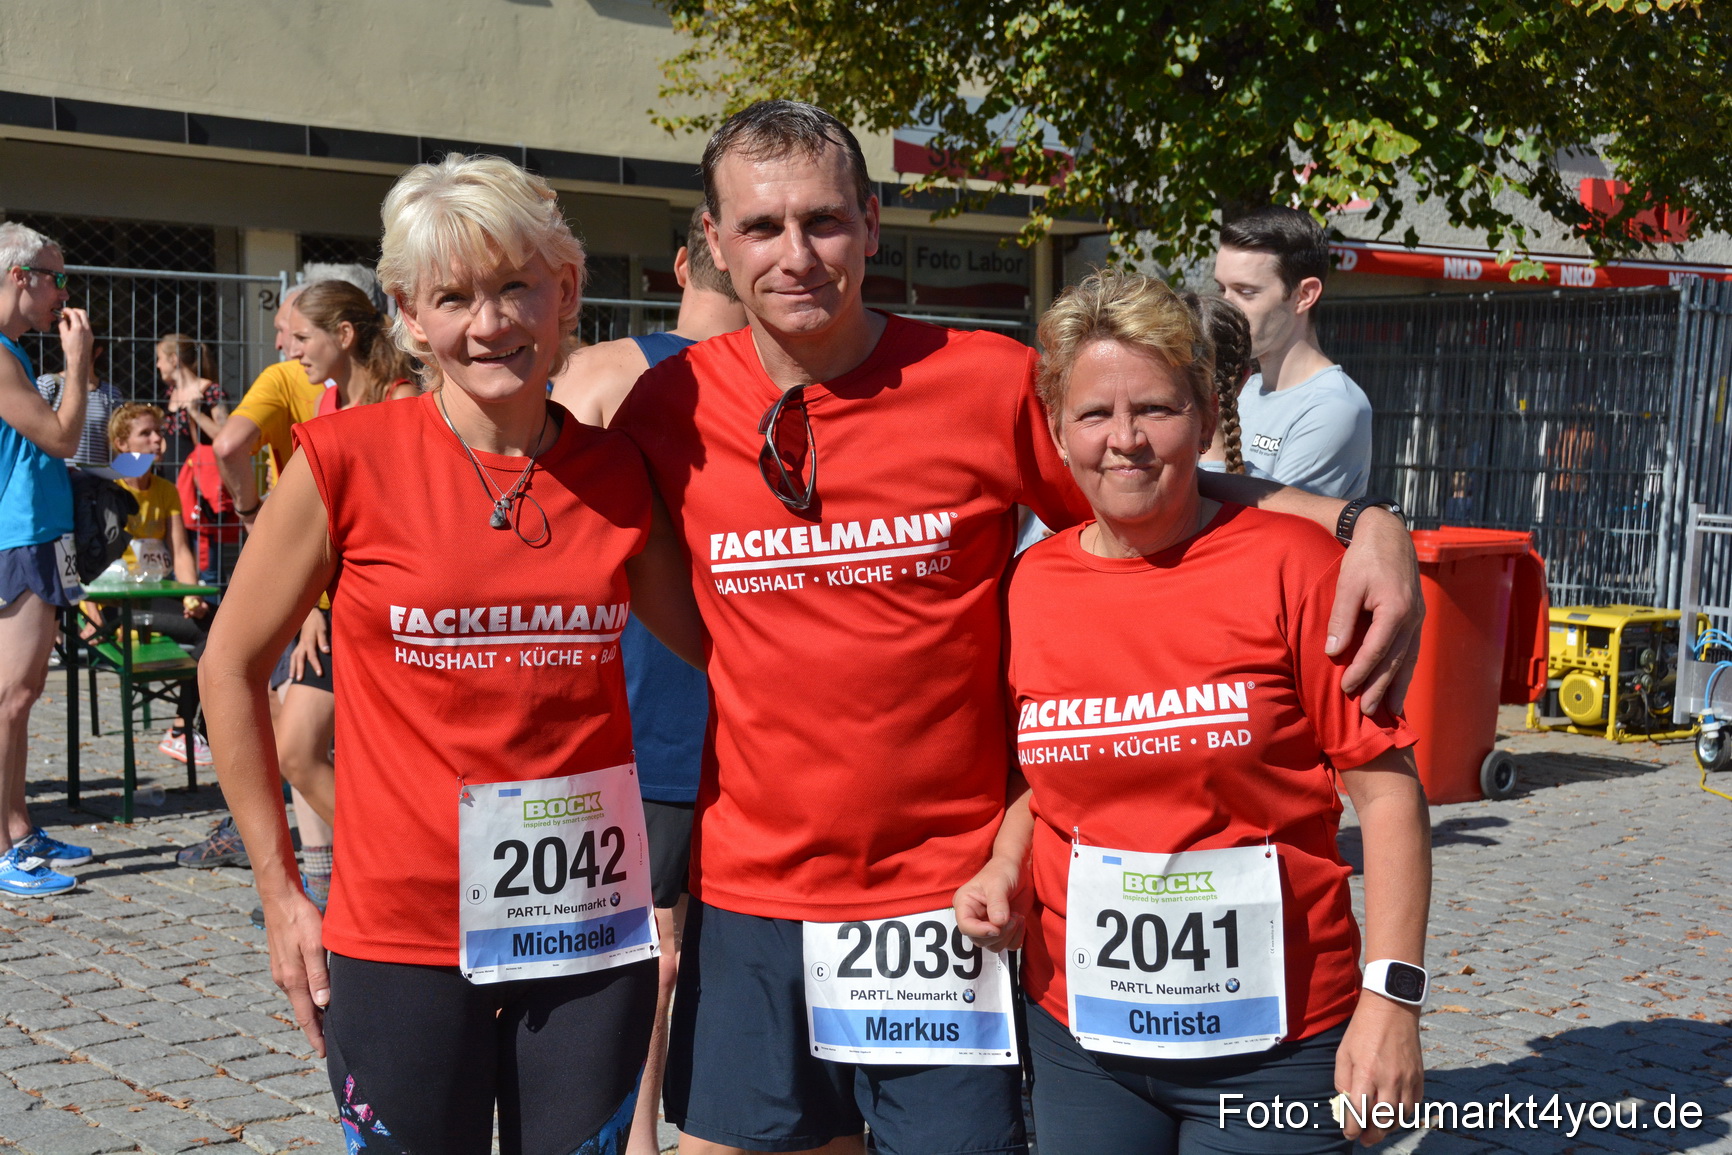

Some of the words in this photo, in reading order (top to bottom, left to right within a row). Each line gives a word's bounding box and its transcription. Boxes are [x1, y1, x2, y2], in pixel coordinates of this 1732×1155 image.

[917, 246, 962, 270] Foto
[968, 250, 1024, 273] Labor
[1443, 256, 1483, 280] NKD
[1560, 264, 1596, 287] NKD
[64, 554, 77, 576] 23
[714, 572, 806, 595] HAUSHALT
[826, 564, 893, 586] KÜCHE
[915, 555, 951, 577] BAD
[390, 601, 628, 634] FACKELMANN
[395, 647, 497, 669] HAUSHALT
[519, 646, 583, 667] KÜCHE
[600, 645, 617, 664] BAD
[1113, 735, 1181, 757] KÜCHE
[1206, 729, 1252, 749] BAD
[523, 790, 604, 821] BOCK
[523, 821, 551, 829] inspired
[552, 819, 562, 827] by
[562, 816, 580, 825] smart
[580, 812, 605, 822] concepts
[493, 826, 627, 898] 2042
[472, 889, 480, 900] D
[1123, 871, 1216, 895] BOCK
[507, 905, 551, 919] PARTL
[554, 898, 607, 915] Neumarkt
[1122, 893, 1149, 903] inspired
[1150, 896, 1160, 904] by
[1161, 895, 1183, 903] smart
[1184, 893, 1218, 902] concepts
[512, 924, 616, 958] Michaela
[836, 920, 984, 980] 2039
[1096, 908, 1240, 973] 2041
[1078, 953, 1085, 964] D
[816, 966, 824, 977] C
[850, 989, 893, 1001] PARTL
[897, 989, 958, 1001] Neumarkt
[1110, 980, 1153, 994] PARTL
[1156, 982, 1220, 995] Neumarkt
[865, 1016, 960, 1042] Markus
[1128, 1009, 1221, 1036] Christa
